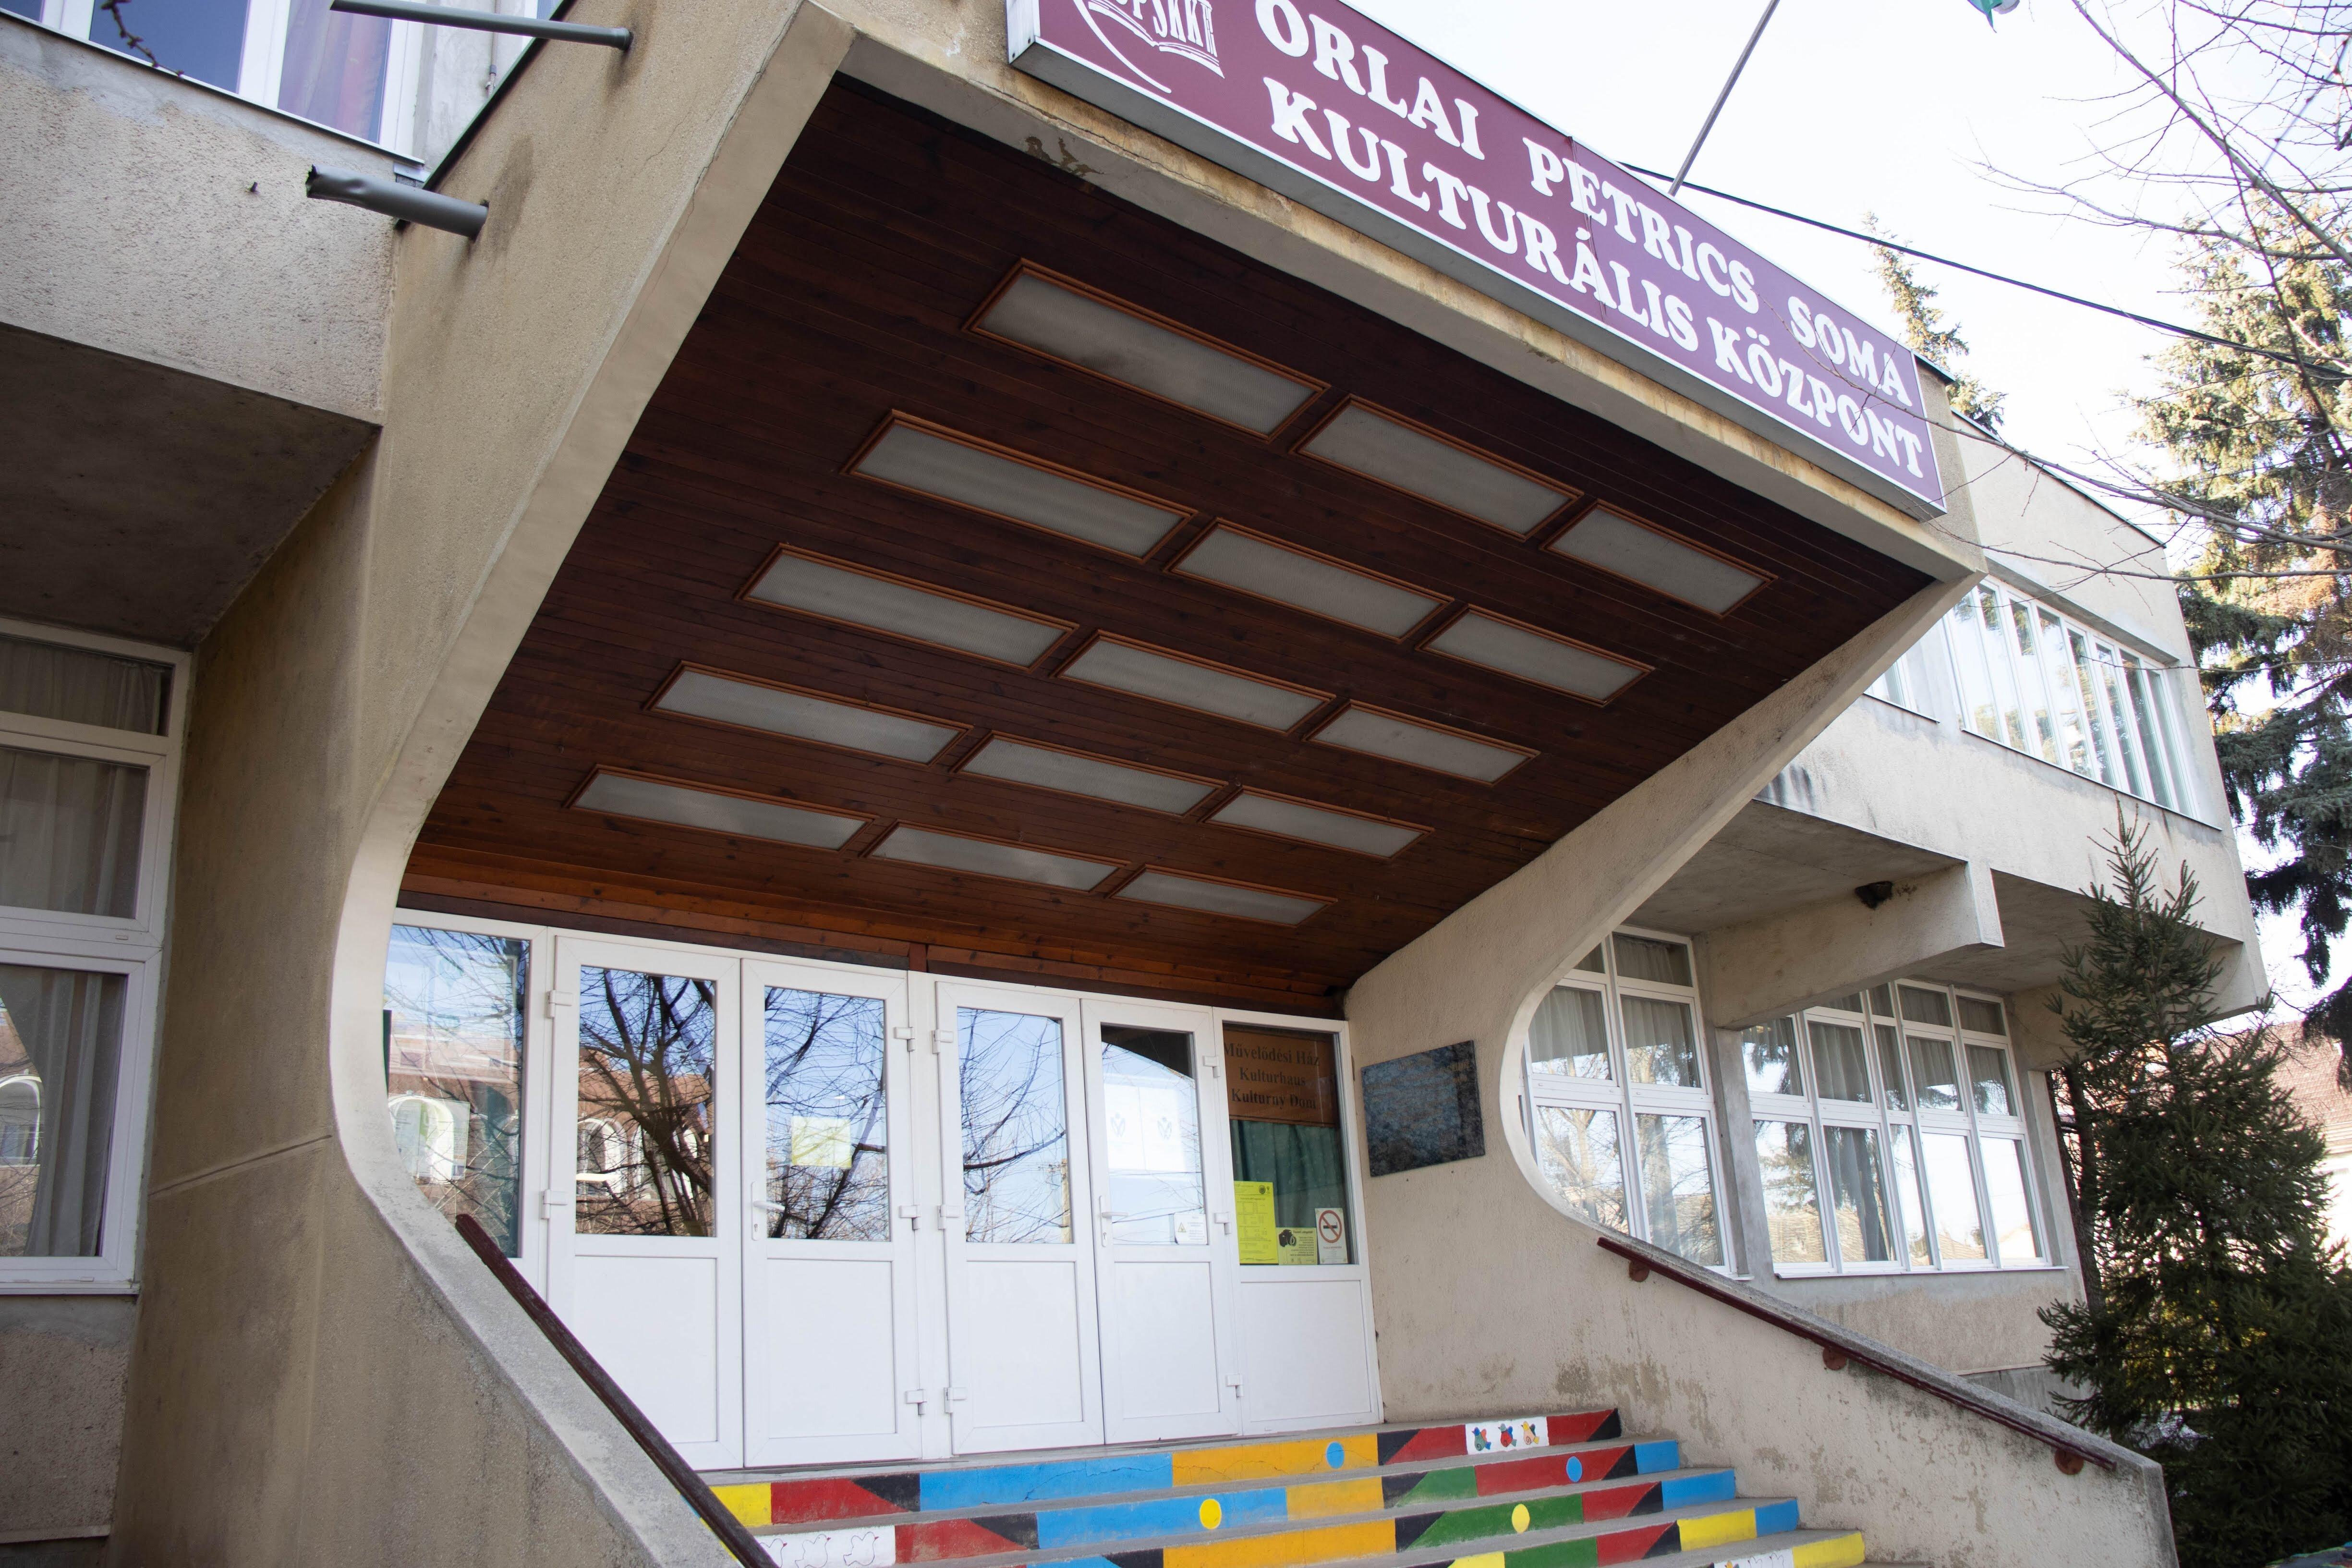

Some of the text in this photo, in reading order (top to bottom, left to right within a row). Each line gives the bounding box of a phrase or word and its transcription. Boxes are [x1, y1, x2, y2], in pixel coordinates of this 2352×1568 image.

[1255, 0, 1913, 407] ORLAI PETRICS SOMA
[1263, 77, 1923, 478] KULTURÁLIS KÖZPONT
[1224, 1042, 1320, 1066] Művelődési Ház
[1239, 1066, 1306, 1086] Kulturhaus
[1290, 1094, 1316, 1109] Dom
